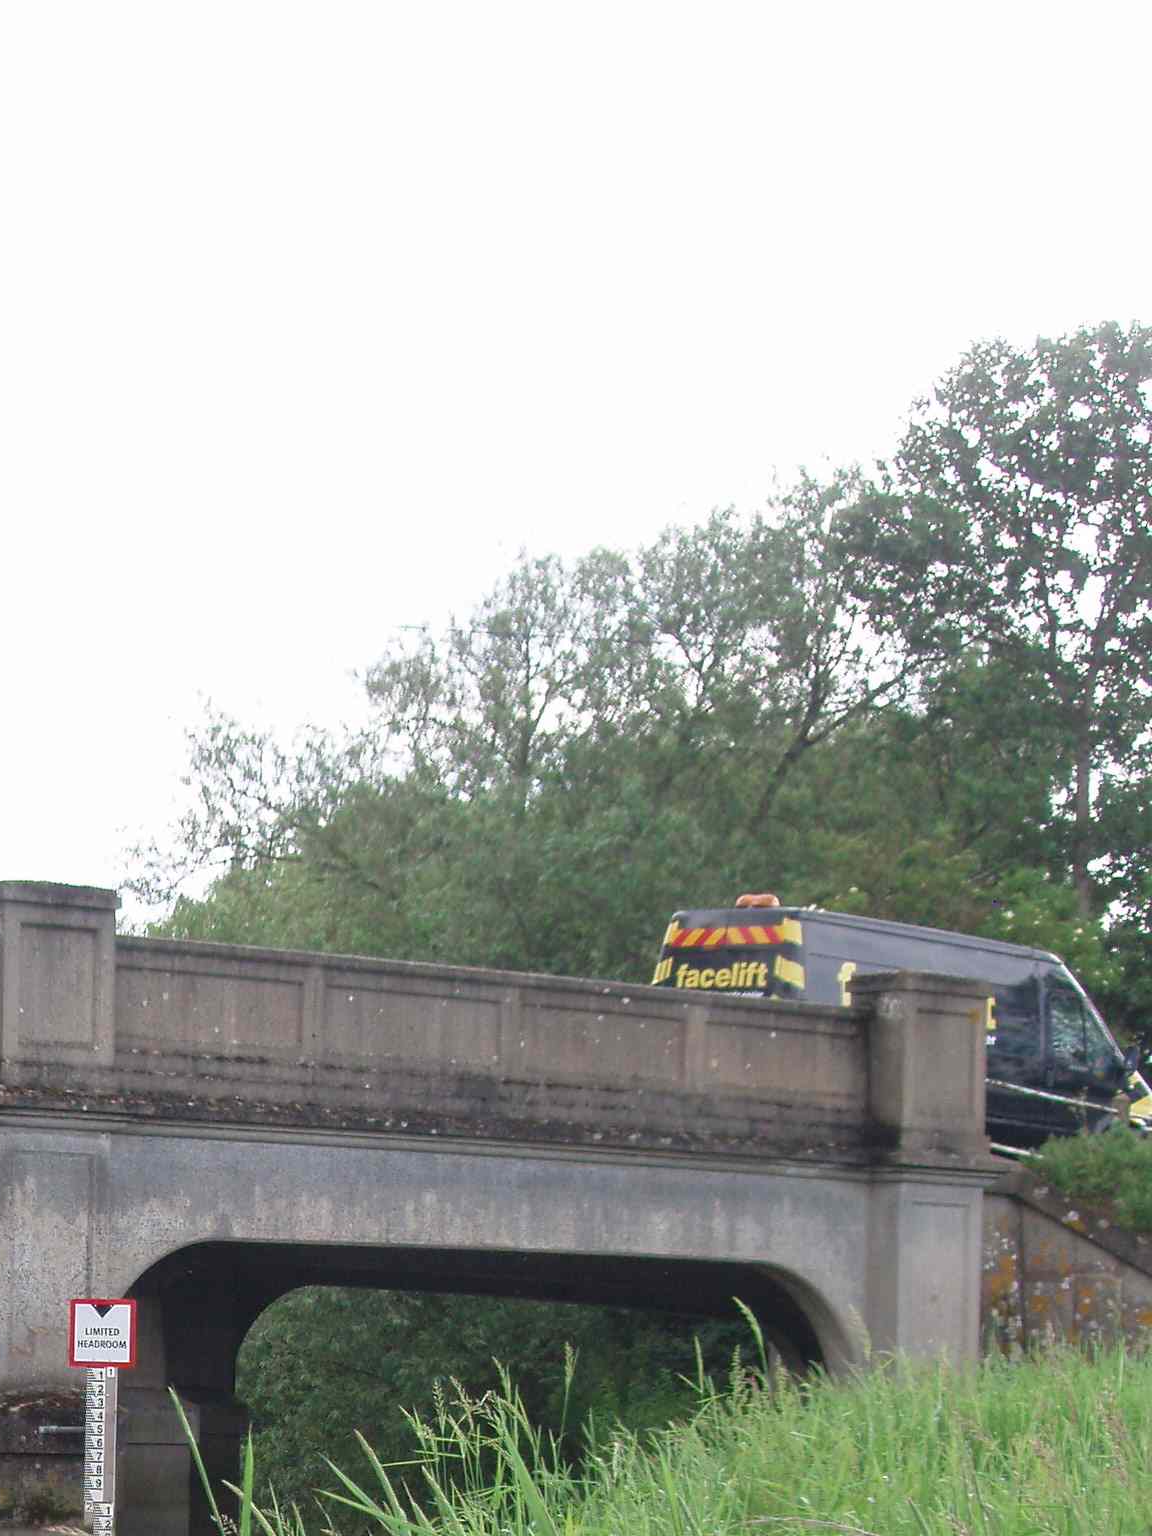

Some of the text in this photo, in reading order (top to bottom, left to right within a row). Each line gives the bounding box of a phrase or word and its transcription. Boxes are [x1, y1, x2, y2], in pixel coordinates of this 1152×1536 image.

[676, 961, 768, 989] facelift
[85, 1327, 120, 1336] LIMITED
[77, 1340, 127, 1349] HEADROOM
[97, 1385, 104, 1393] 2
[97, 1398, 104, 1406] 3
[97, 1412, 103, 1421] 4
[97, 1425, 103, 1434] 5
[96, 1438, 103, 1447] 6
[96, 1452, 103, 1460] 7
[96, 1465, 102, 1474] 8
[95, 1479, 102, 1487] 9
[105, 1520, 111, 1529] 2
